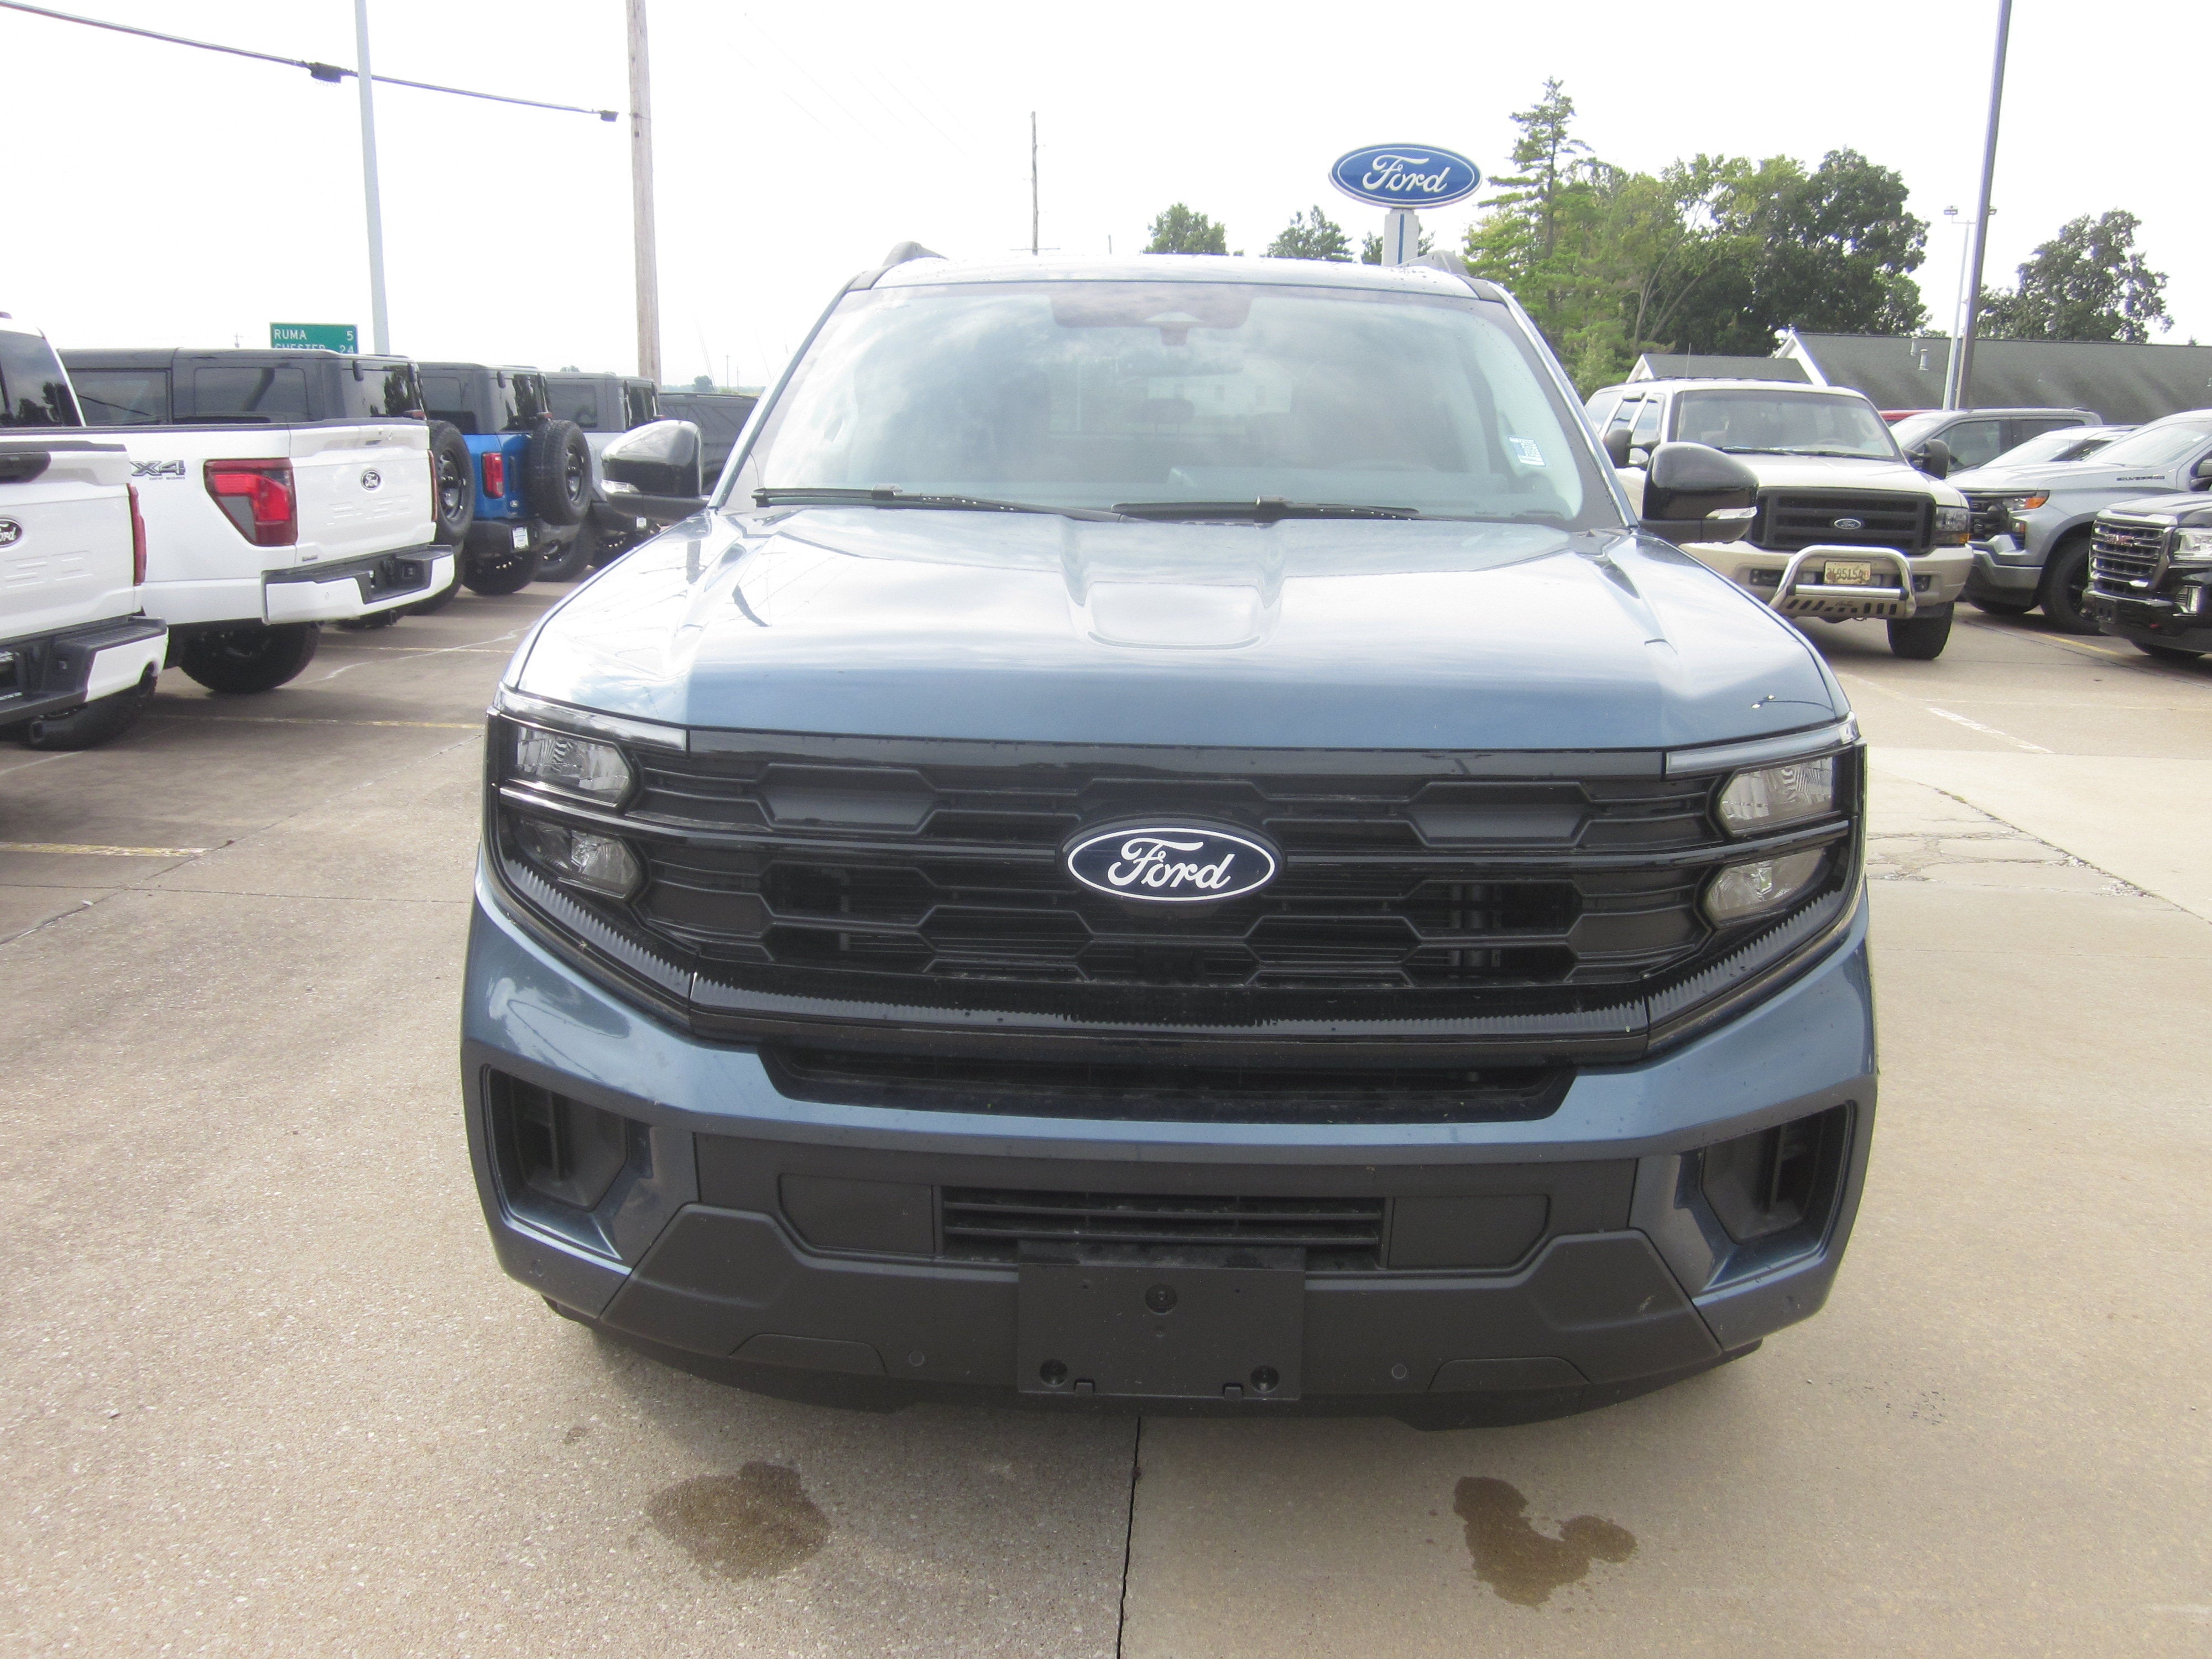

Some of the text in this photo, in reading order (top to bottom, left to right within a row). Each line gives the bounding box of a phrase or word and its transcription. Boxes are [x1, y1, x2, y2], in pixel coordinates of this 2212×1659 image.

[1363, 154, 1451, 192] Ford
[274, 328, 354, 341] RUMA 5
[339, 345, 354, 353] 24
[129, 460, 186, 476] X4
[0, 523, 17, 542] ord
[1108, 837, 1235, 889] Ford
